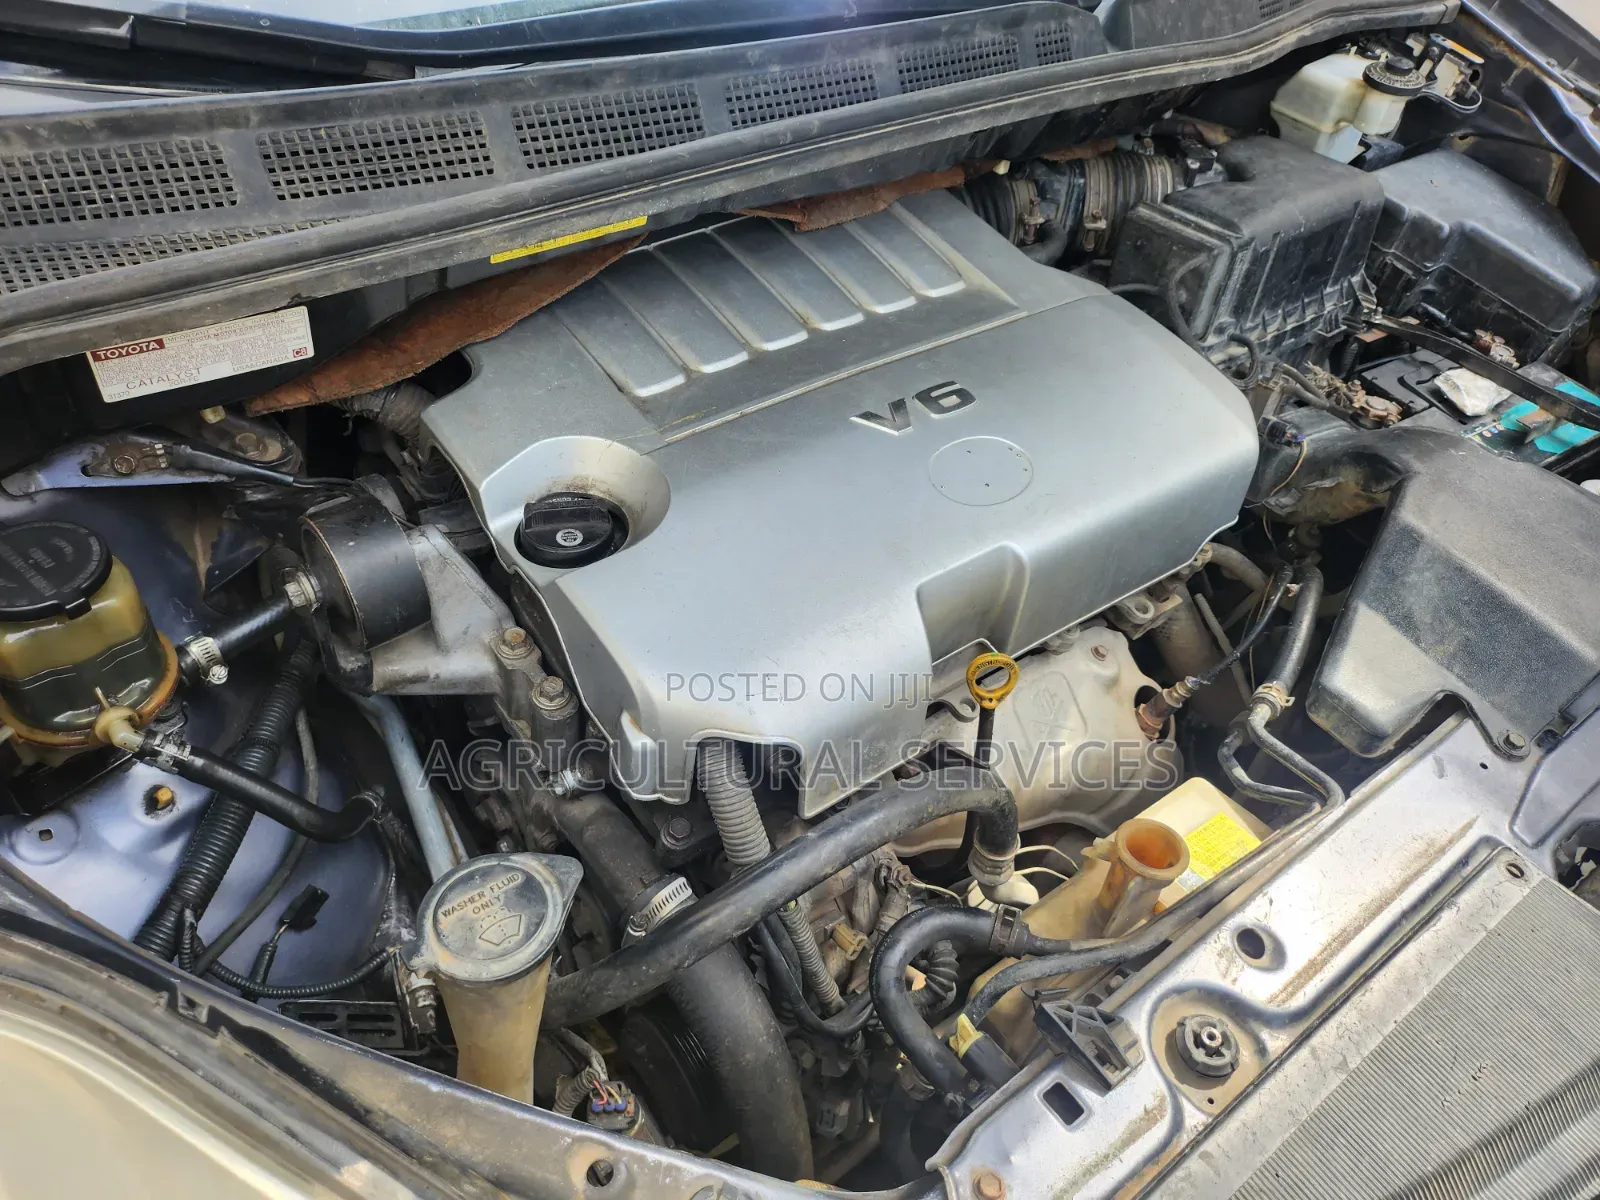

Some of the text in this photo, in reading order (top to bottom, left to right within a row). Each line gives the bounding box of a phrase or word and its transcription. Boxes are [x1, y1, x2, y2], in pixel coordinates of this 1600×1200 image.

[213, 329, 238, 338] MOTOR
[96, 341, 160, 360] TOYOTA
[293, 347, 307, 357] C8
[126, 367, 202, 390] CATALYST
[850, 380, 977, 436] V6
[440, 873, 521, 919] WASHER FLUID
[472, 895, 503, 915] ONLY
